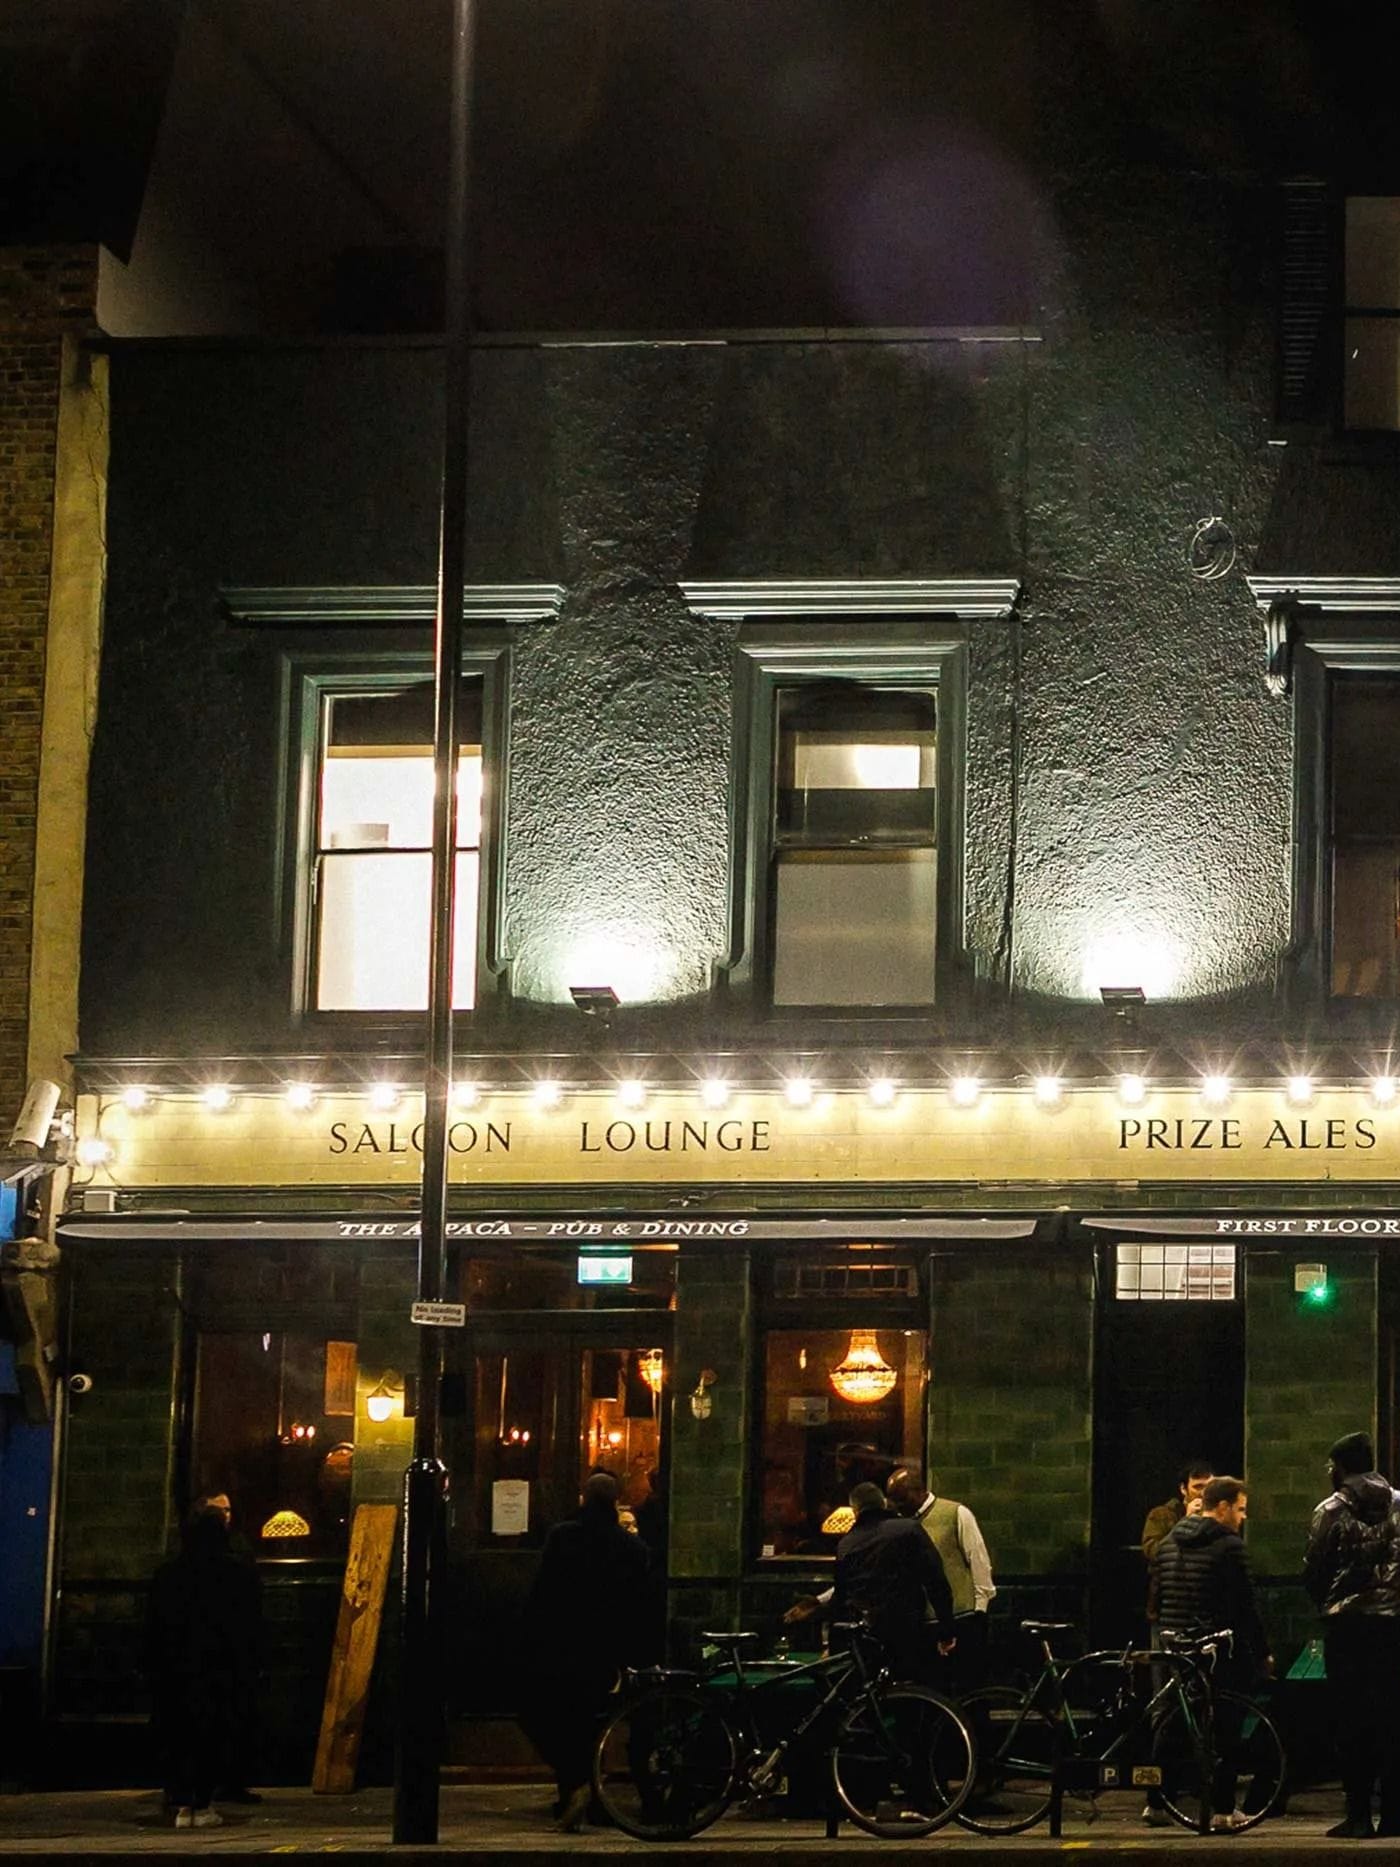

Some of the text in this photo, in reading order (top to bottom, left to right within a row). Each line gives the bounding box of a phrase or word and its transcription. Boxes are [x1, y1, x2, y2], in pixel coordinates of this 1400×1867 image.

[580, 1120, 771, 1152] LOUNGE
[1118, 1119, 1376, 1149] PRIZE ALES
[338, 1223, 400, 1236] THE
[402, 1222, 513, 1236] APACA
[547, 1222, 603, 1236] PUB
[640, 1221, 750, 1236] DINING
[1216, 1219, 1297, 1233] FIRST
[1305, 1219, 1400, 1233] FLOOR
[1104, 1767, 1116, 1782] P
